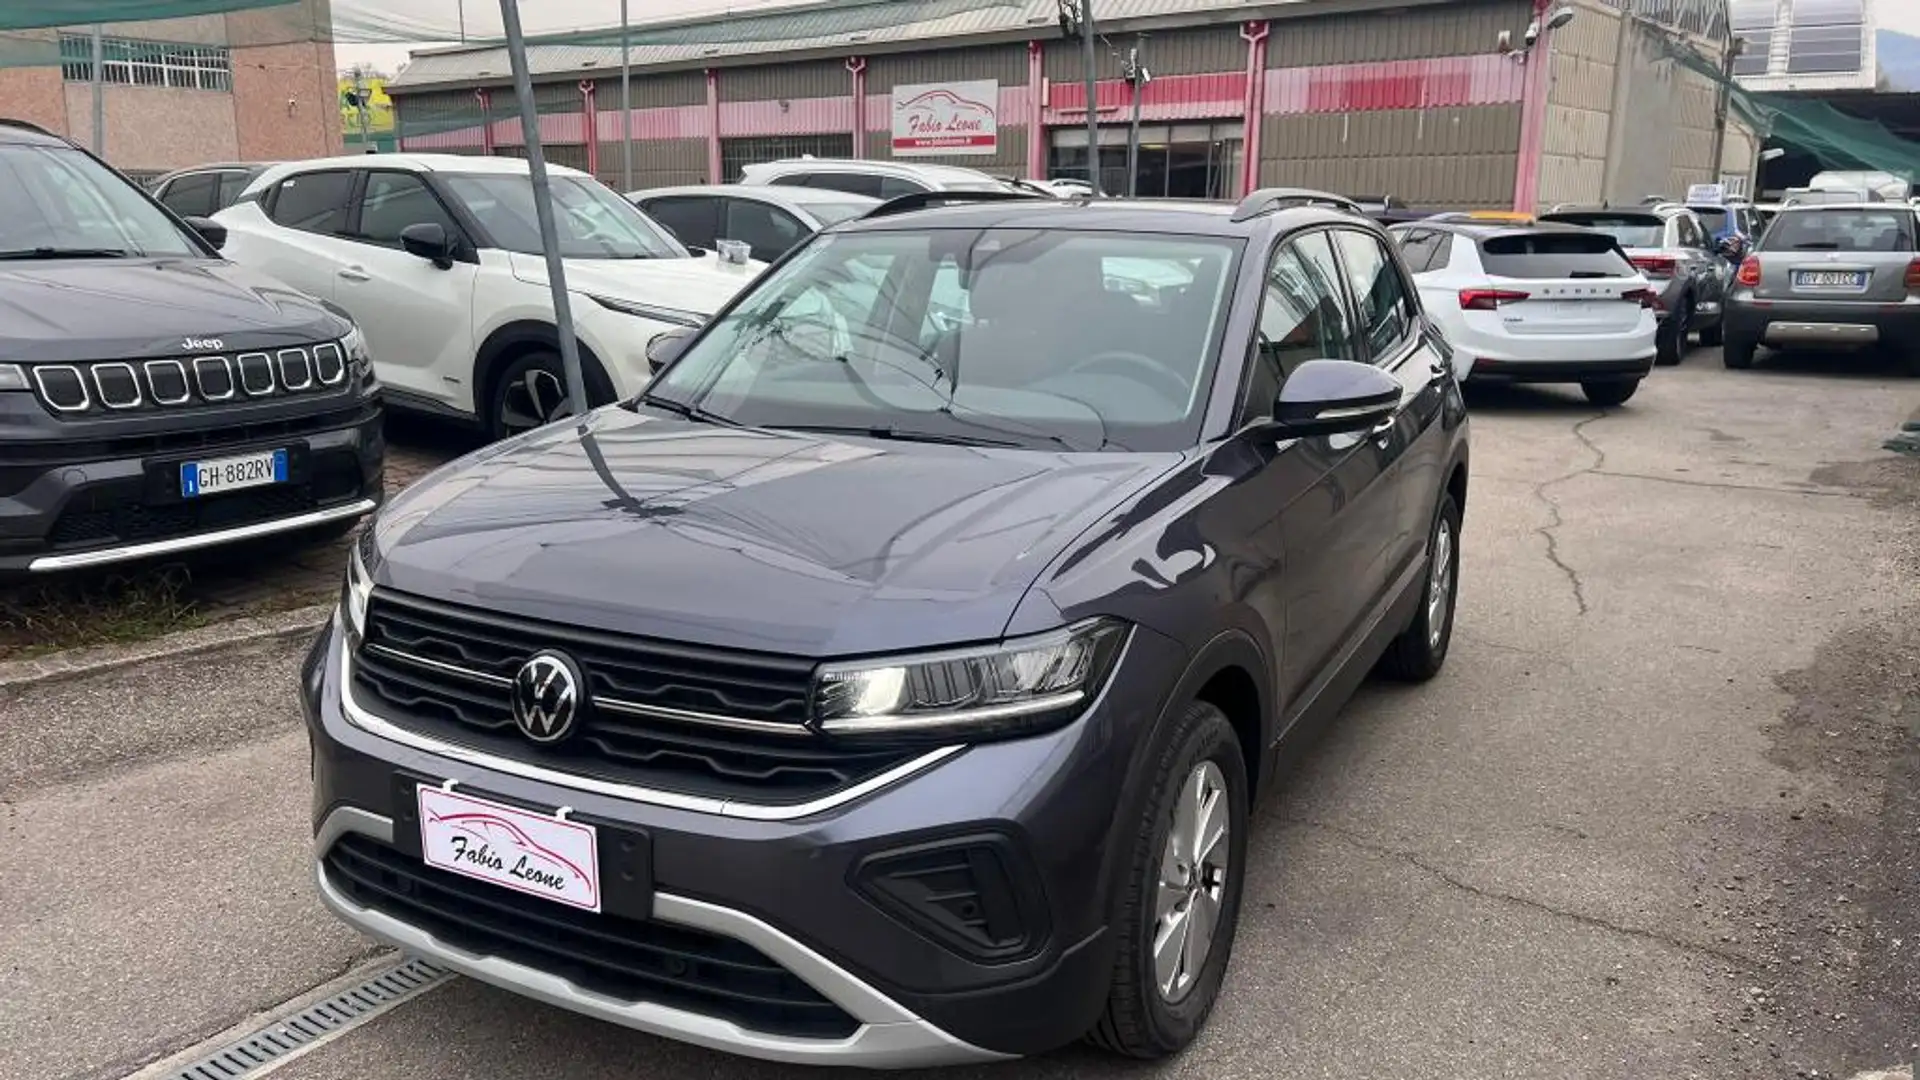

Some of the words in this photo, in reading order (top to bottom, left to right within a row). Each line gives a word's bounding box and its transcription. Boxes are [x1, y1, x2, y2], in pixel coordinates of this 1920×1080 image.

[908, 114, 942, 136] Fabio
[945, 112, 982, 131] Leone
[181, 337, 223, 350] Jeep
[451, 835, 503, 870] Fabio
[509, 855, 567, 890] Leone
